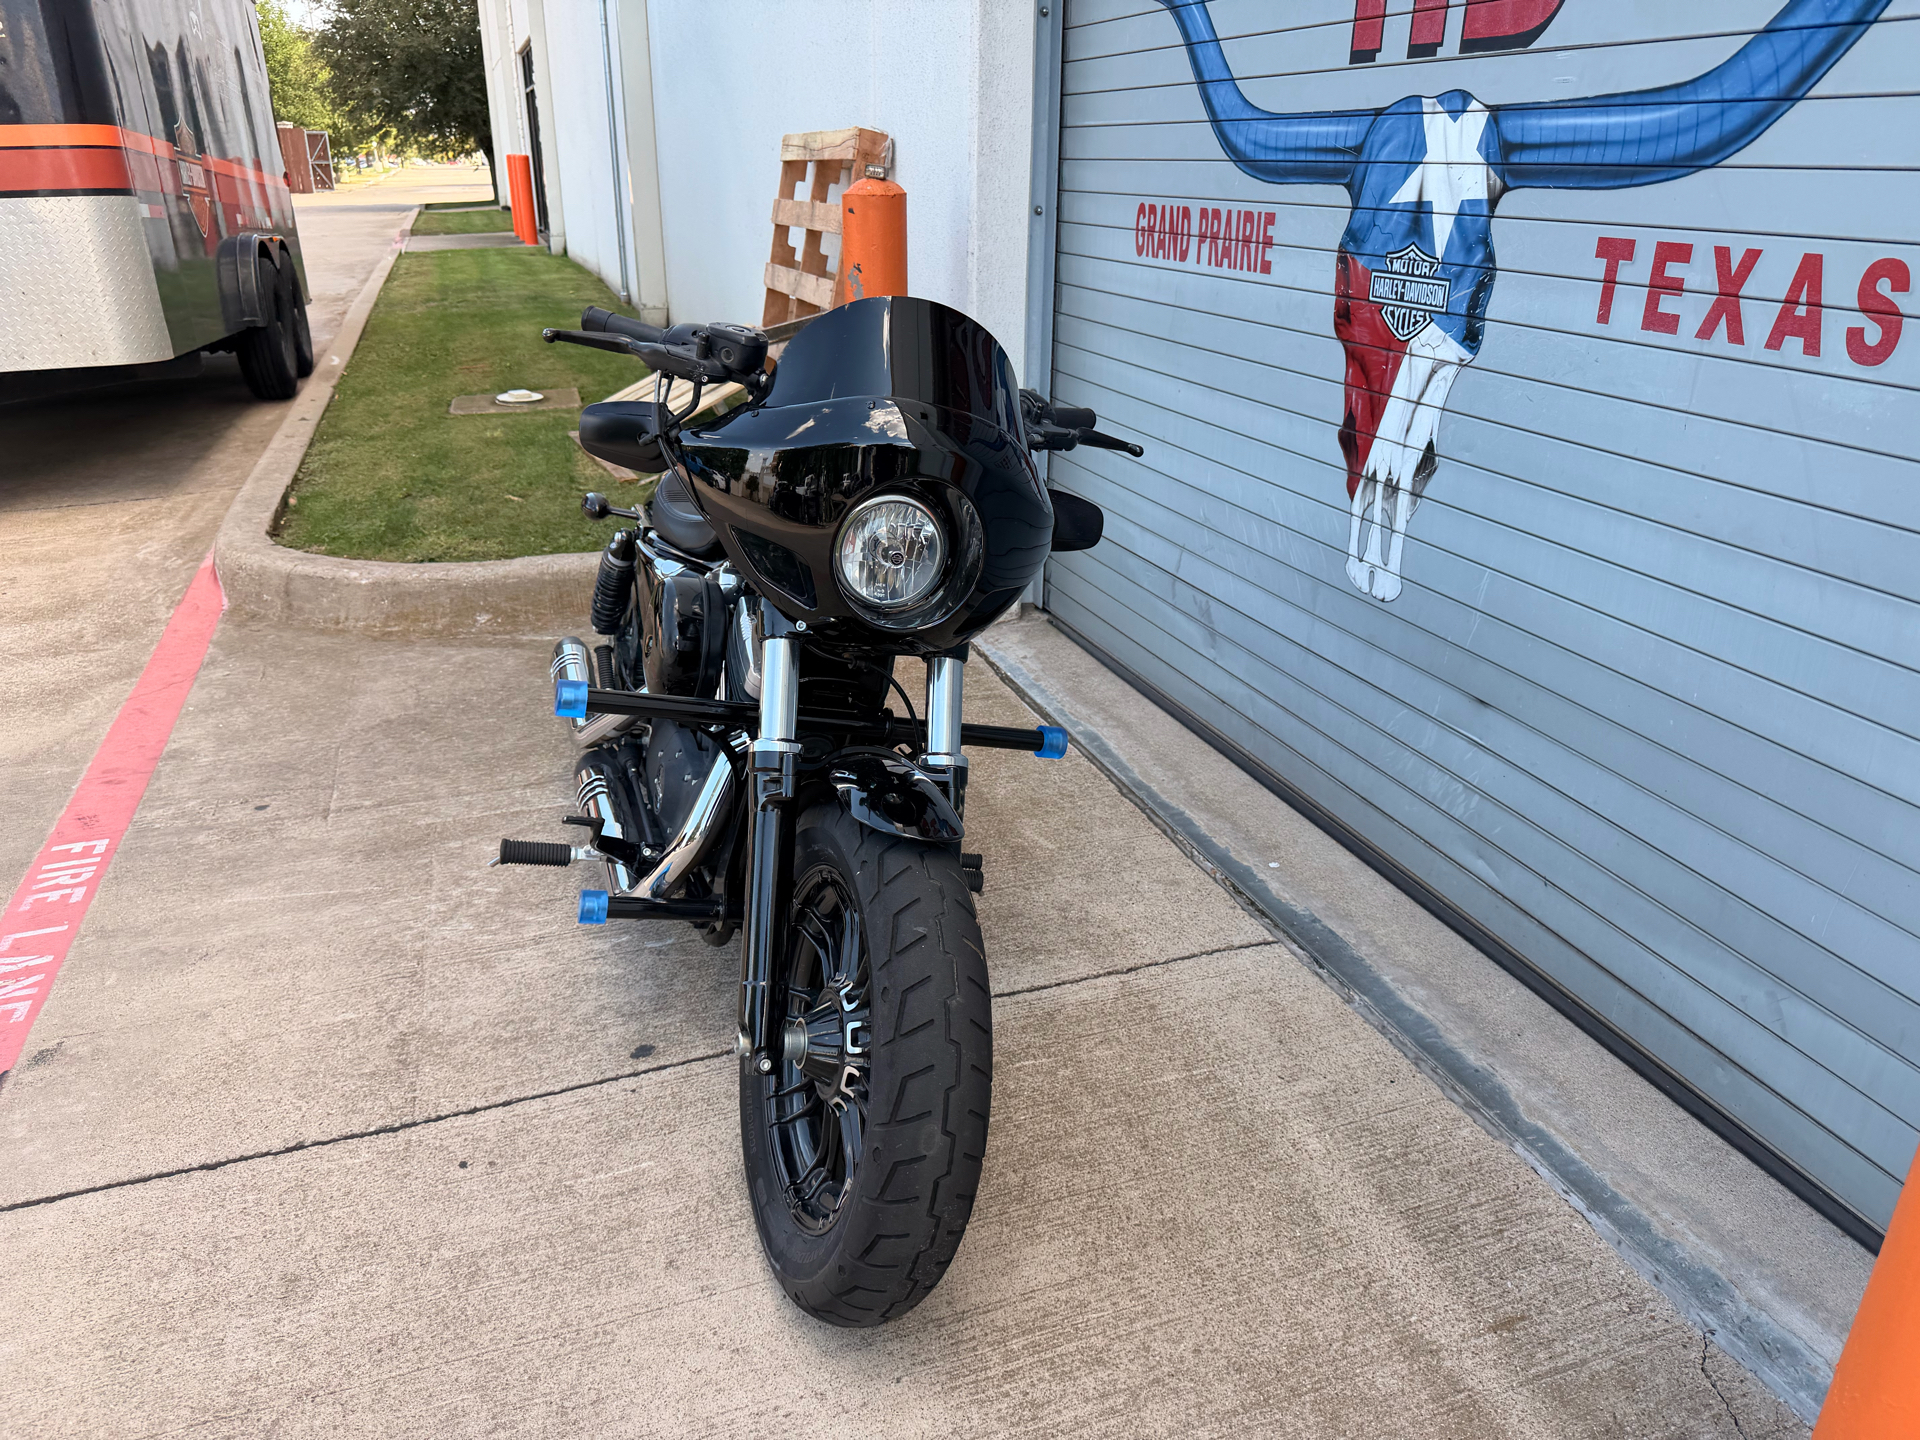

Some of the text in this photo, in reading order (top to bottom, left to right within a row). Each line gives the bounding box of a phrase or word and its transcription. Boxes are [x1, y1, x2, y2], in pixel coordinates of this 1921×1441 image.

[1135, 202, 1276, 275] GRAND PRAIRIE
[1392, 258, 1430, 277] MOTOR
[1373, 277, 1445, 307] HARLEY-DAVIDSON
[1387, 305, 1425, 336] CYCLES
[1595, 236, 1911, 367] TEXAS
[18, 838, 110, 912] FIRE
[746, 1088, 757, 1155] SCORCHER
